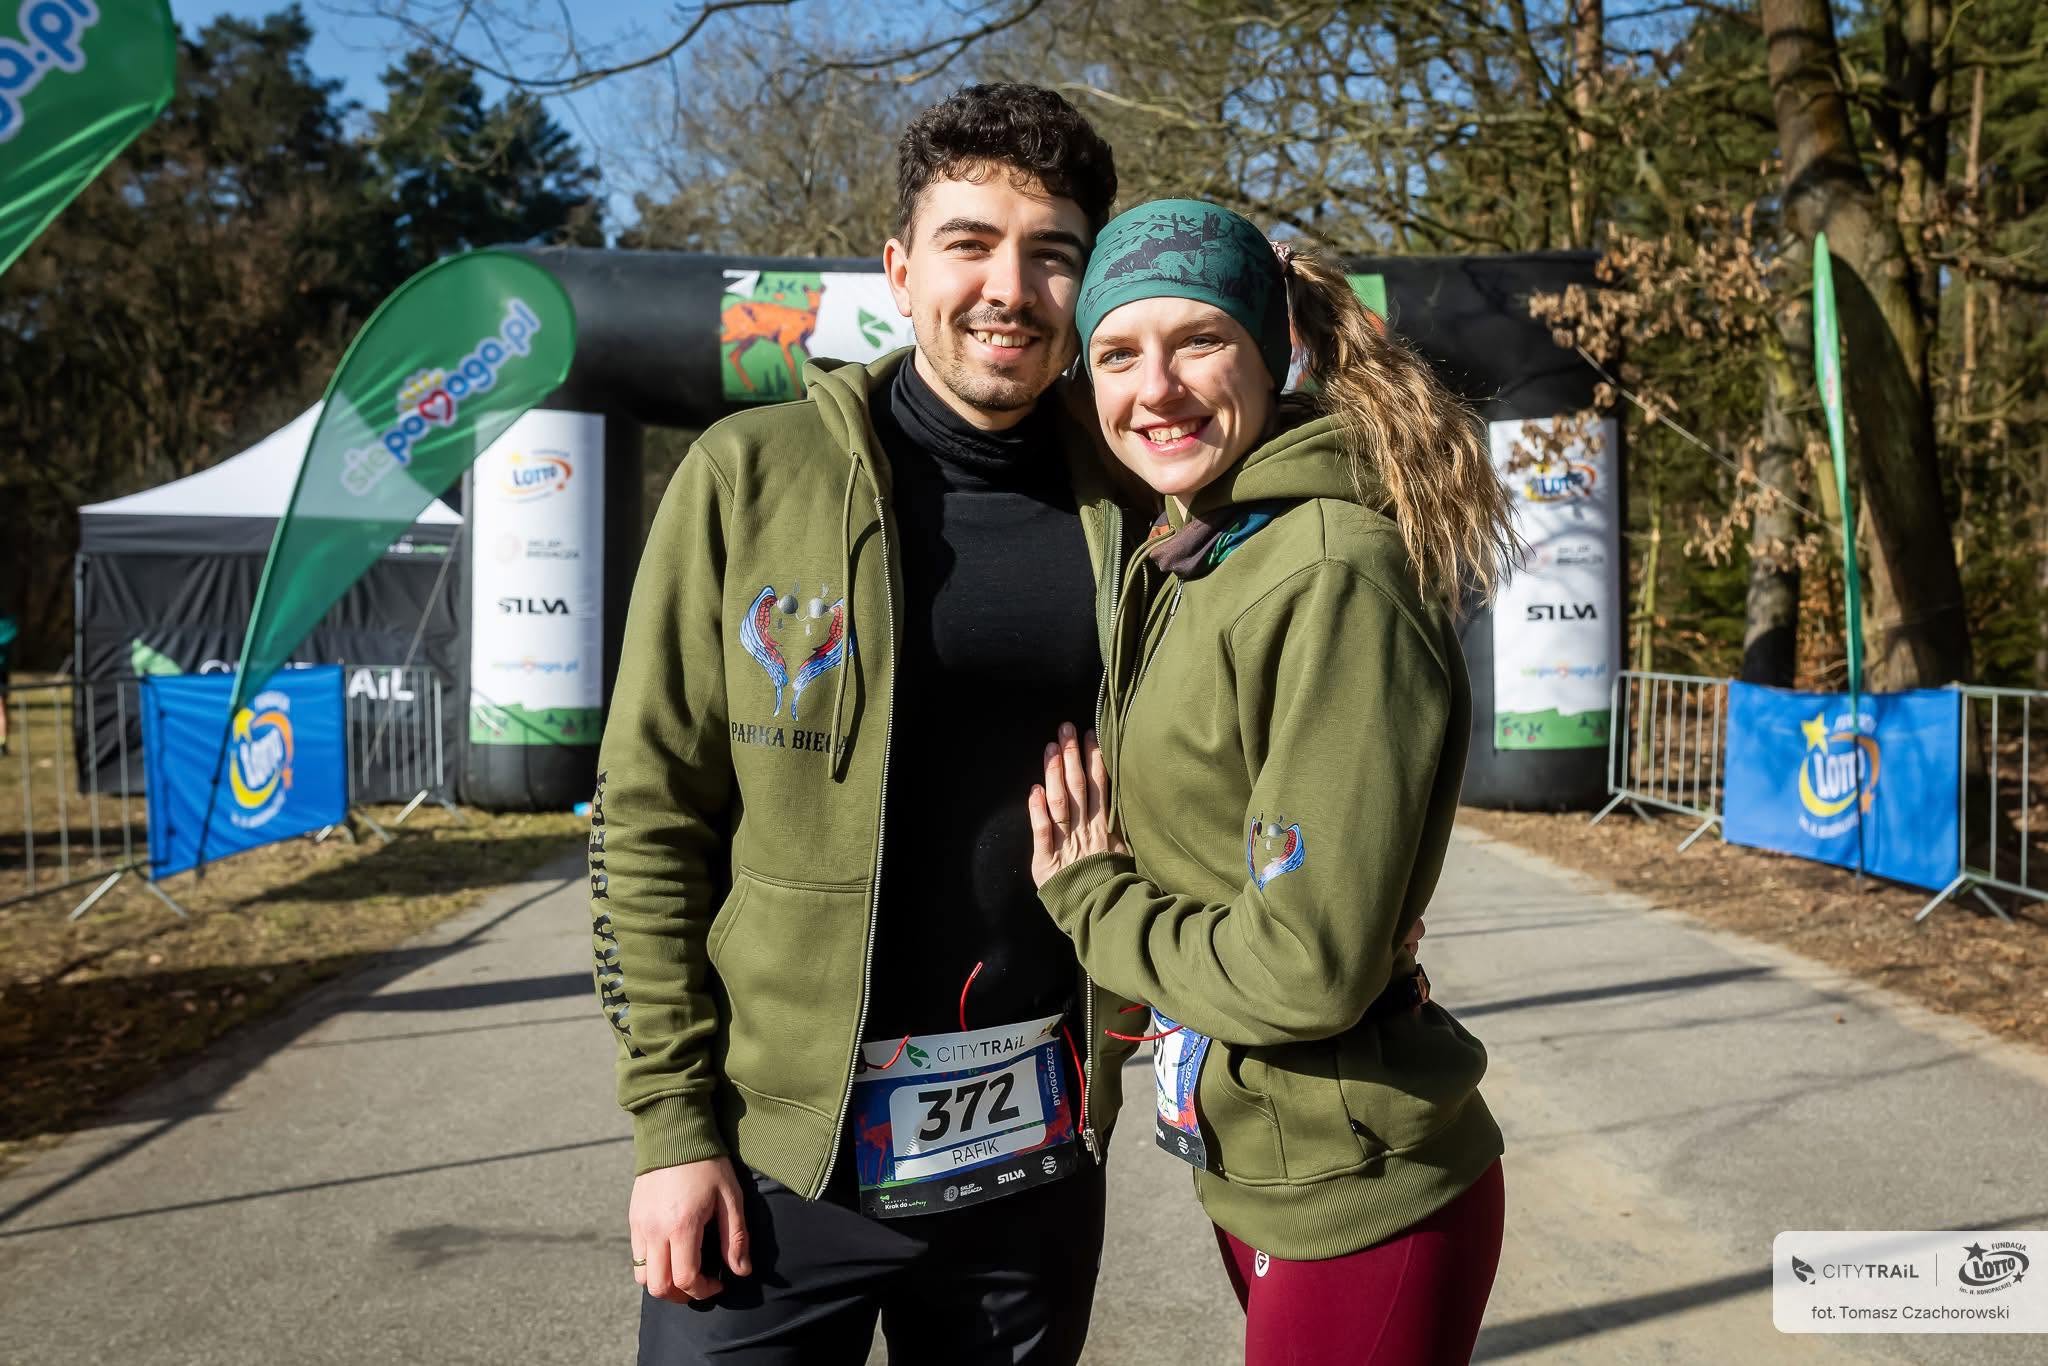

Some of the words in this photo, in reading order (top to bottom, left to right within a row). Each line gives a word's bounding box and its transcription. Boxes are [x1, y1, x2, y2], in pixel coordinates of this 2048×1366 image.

[497, 597, 569, 614] SILVA
[1527, 604, 1597, 621] SILVA
[731, 721, 785, 748] PARKA
[594, 910, 646, 1060] ARKA
[1046, 1047, 1061, 1107] BYDGOSZCZ
[918, 1072, 1020, 1142] 372
[952, 1139, 1000, 1165] RAFIK
[997, 1169, 1026, 1185] SILVA
